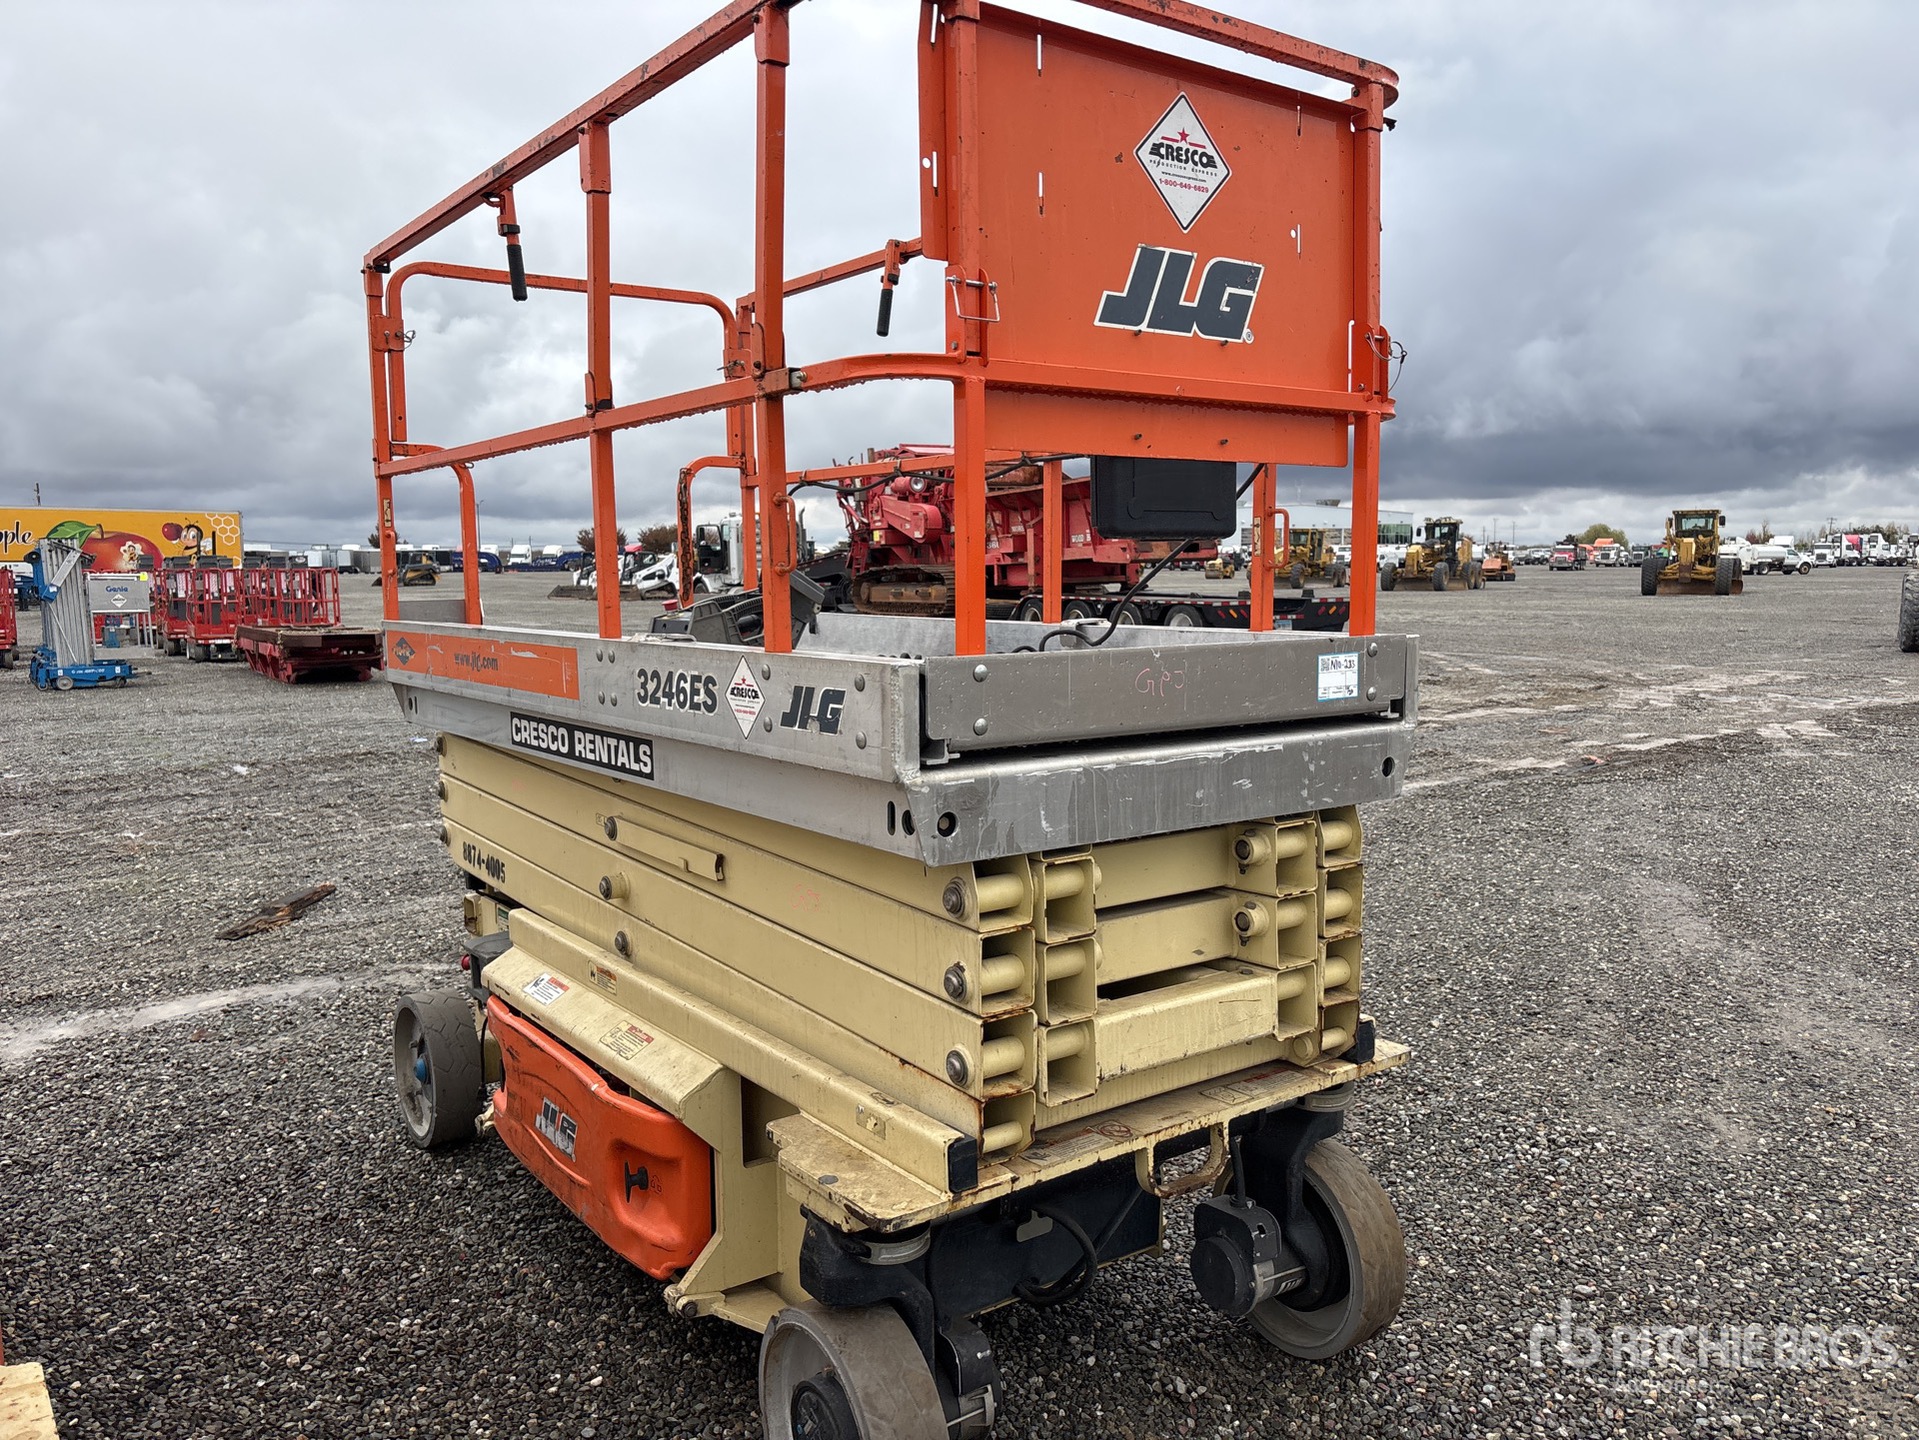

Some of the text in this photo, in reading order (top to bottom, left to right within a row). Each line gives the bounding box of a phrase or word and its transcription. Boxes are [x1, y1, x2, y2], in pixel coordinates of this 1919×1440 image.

[1149, 142, 1218, 169] CRESCO
[1093, 243, 1265, 343] JLG
[636, 667, 718, 716] 3246ES
[729, 686, 760, 699] CRESCO
[780, 685, 847, 735] JLG
[511, 716, 652, 774] CRESCO RENTALS
[462, 840, 506, 884] 8874-4005
[534, 1096, 578, 1158] JLG
